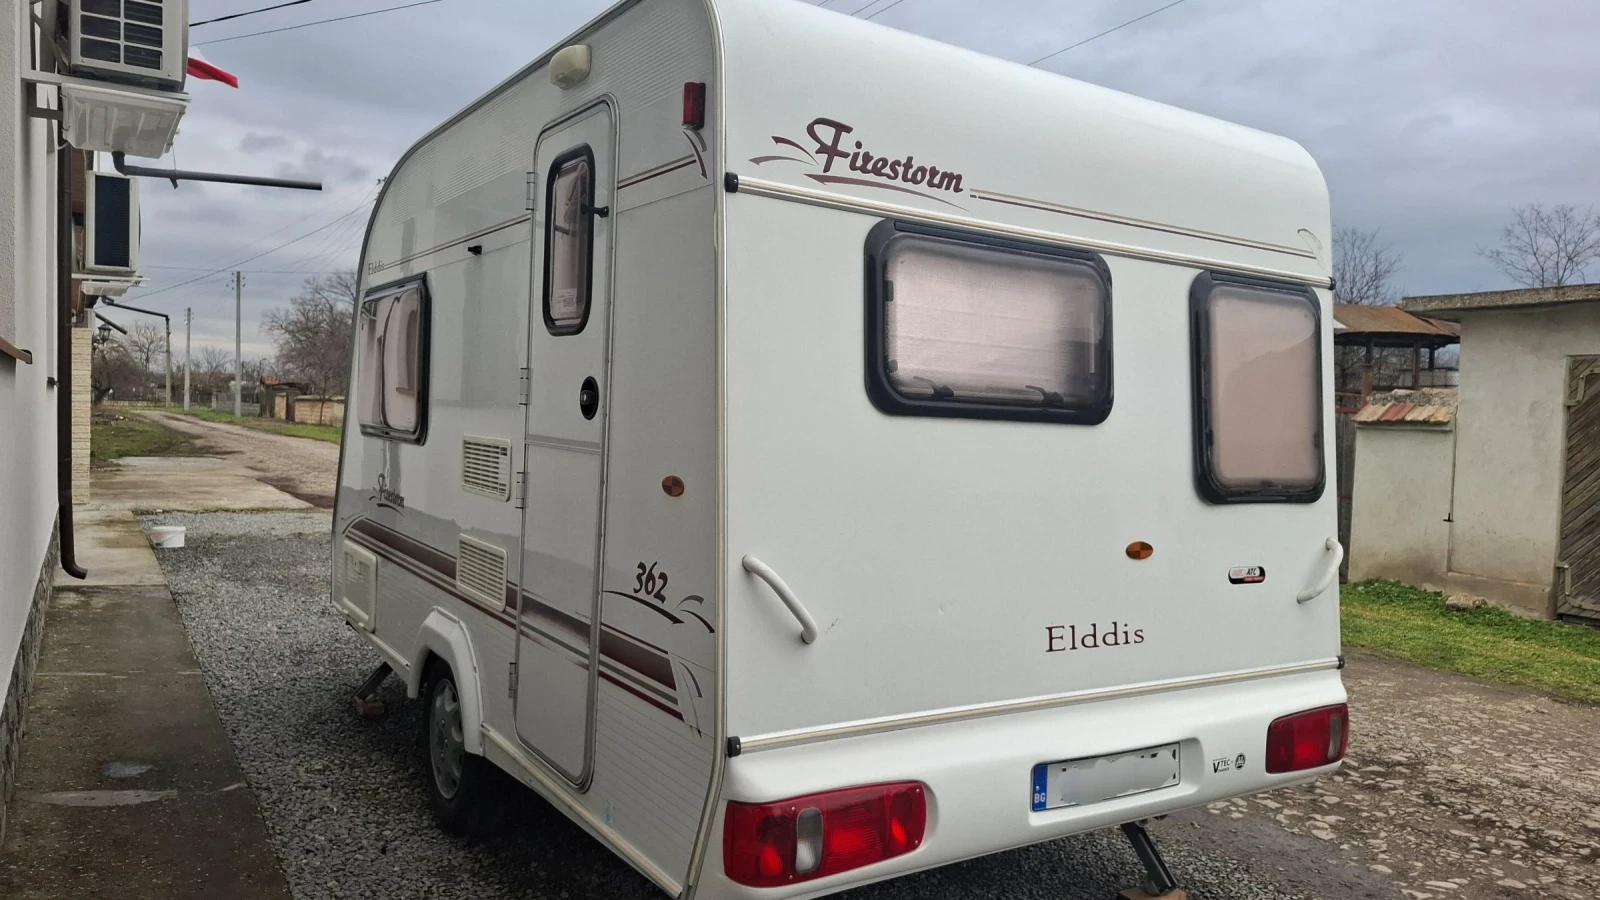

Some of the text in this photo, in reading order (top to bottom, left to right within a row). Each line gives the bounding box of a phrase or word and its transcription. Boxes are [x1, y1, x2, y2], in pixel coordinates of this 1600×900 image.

[806, 117, 964, 193] Firestorm
[633, 561, 668, 604] 362
[1045, 621, 1144, 652] Elddis
[1034, 792, 1046, 804] BG
